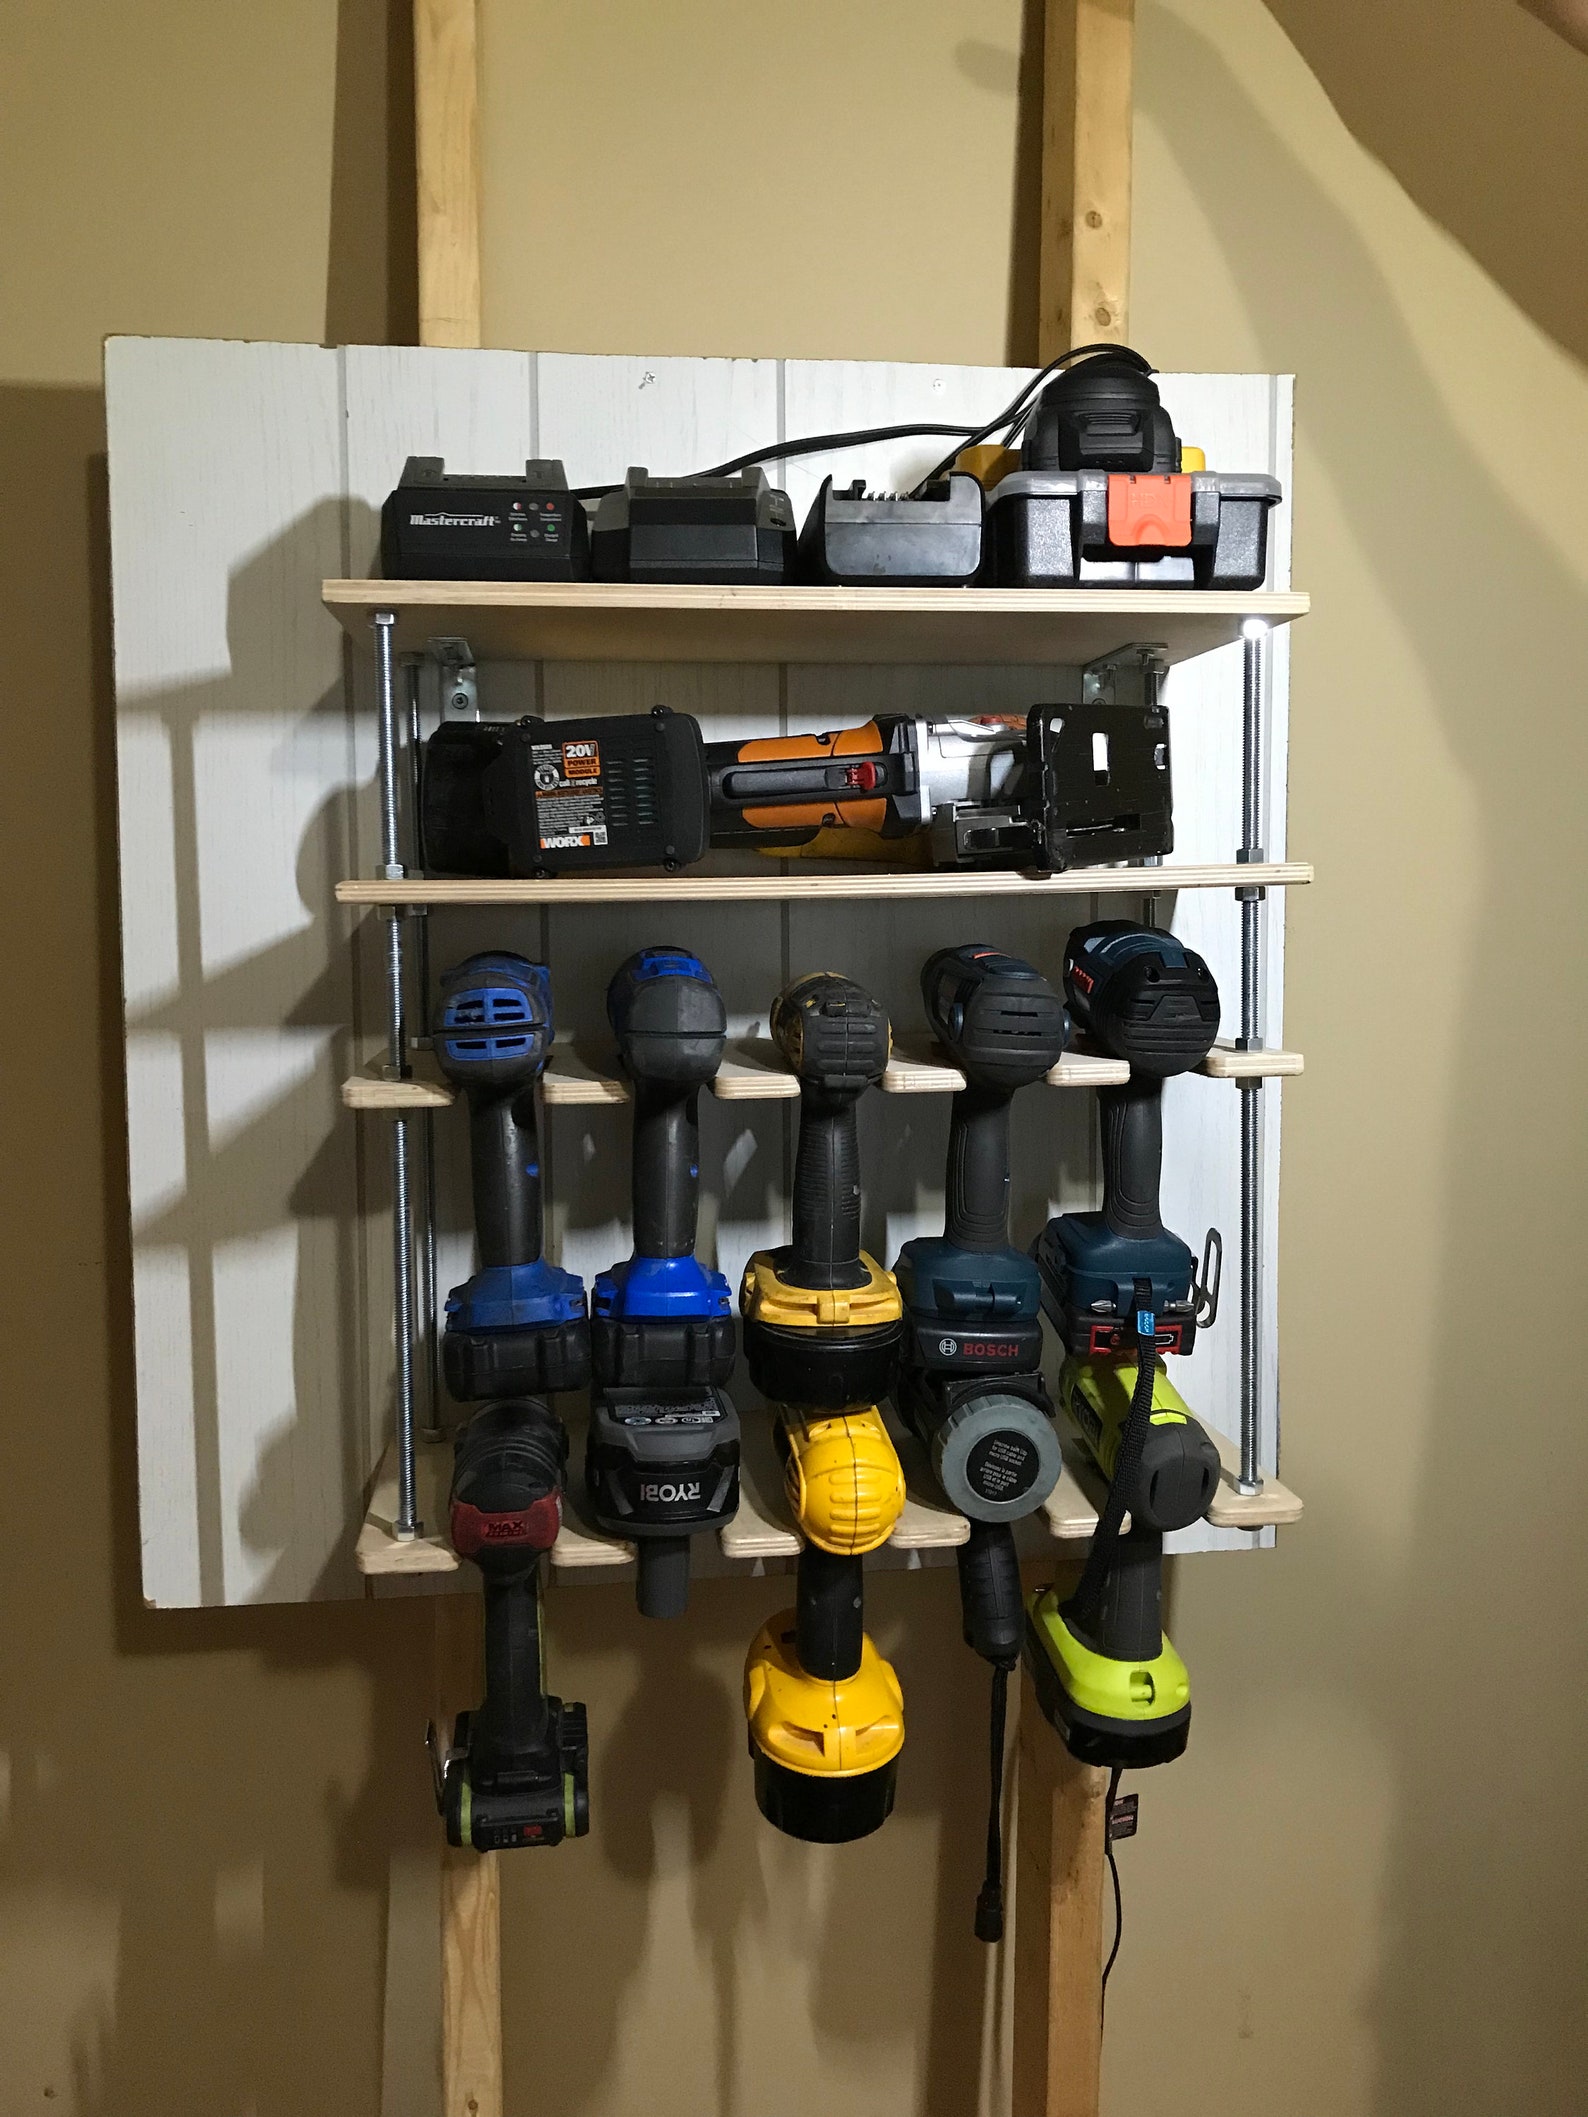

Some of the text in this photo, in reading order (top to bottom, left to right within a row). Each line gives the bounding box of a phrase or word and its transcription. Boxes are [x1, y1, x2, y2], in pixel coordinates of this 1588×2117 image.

[410, 512, 495, 527] Mastercraft
[565, 744, 596, 757] 20V
[567, 759, 597, 767] POWER
[544, 836, 583, 849] WORX
[963, 1343, 1019, 1357] BOSCH
[640, 1482, 701, 1502] RYOBI
[488, 1520, 524, 1533] MAX
